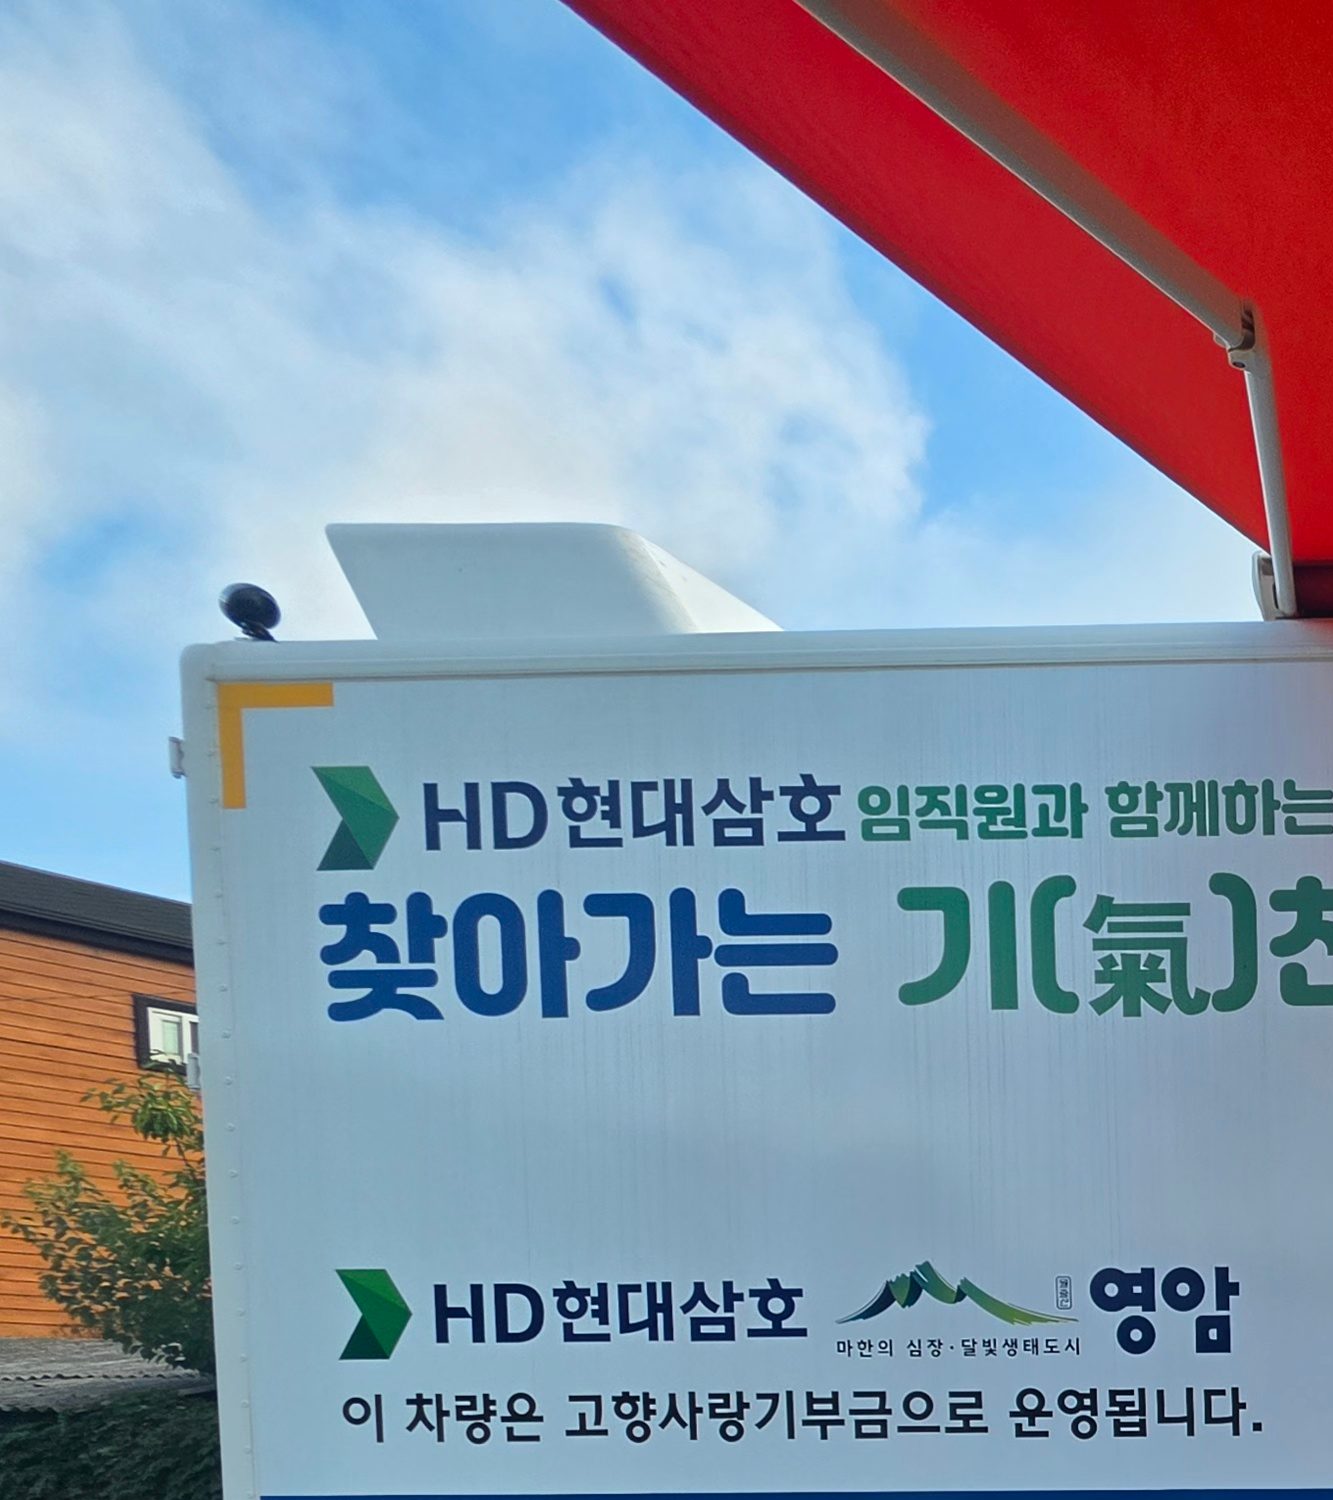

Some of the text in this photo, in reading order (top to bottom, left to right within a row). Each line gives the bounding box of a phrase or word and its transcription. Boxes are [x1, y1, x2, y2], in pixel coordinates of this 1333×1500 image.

[423, 773, 846, 851] HD현대삼호
[857, 781, 1090, 842] 임직원과
[318, 886, 839, 1023] 찾아가는
[432, 1277, 809, 1344] HD현대삼호
[1089, 1265, 1240, 1355] 영암
[836, 1338, 894, 1358] 마한의
[342, 1386, 1263, 1445] 이 차량은 고향사랑기부금으로 운영됩니다.
